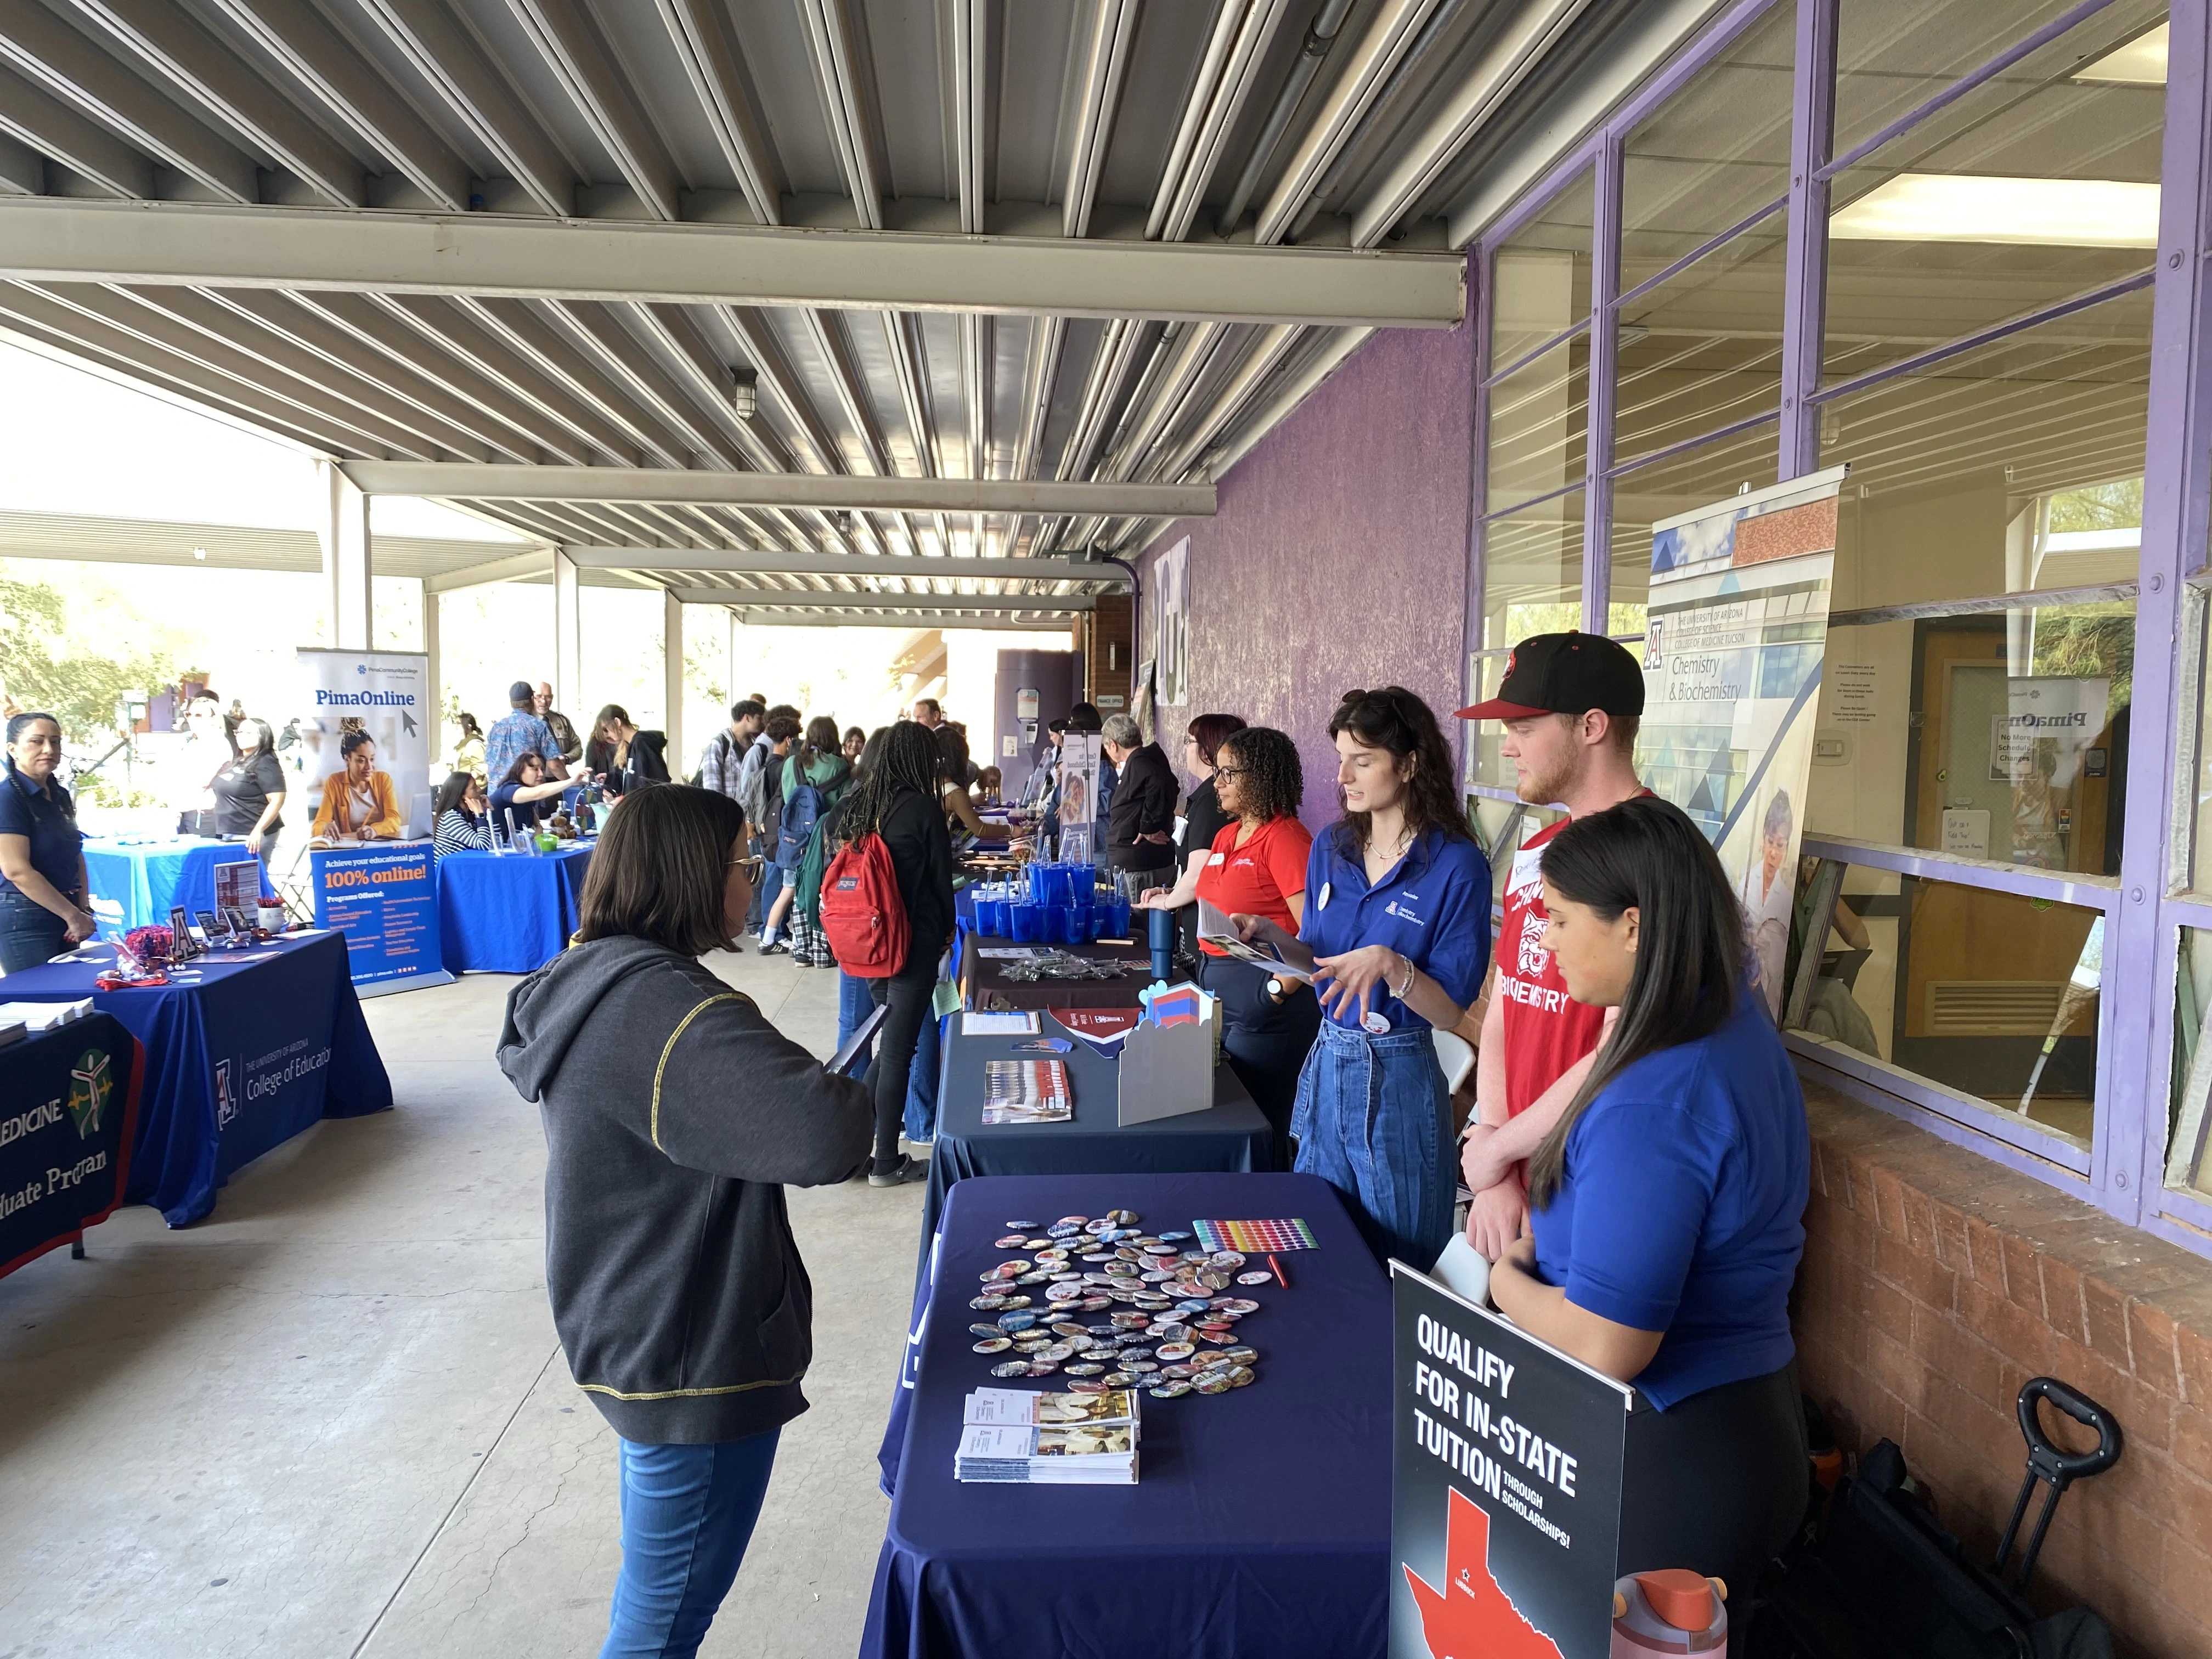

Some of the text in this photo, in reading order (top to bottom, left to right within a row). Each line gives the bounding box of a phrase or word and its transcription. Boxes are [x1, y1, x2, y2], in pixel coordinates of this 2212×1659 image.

[1678, 608, 1743, 625] THE UNIVERSITY OF ARIZONA
[1675, 633, 1746, 649] COLLEGE OF MEDICINE TUCSON
[1676, 623, 1722, 637] COLLEGE OF SCIENCE
[1672, 656, 1720, 678] Chemistry
[315, 690, 415, 706] PimaOnline
[1669, 681, 1742, 704] & Biochemistry
[353, 859, 368, 867] your
[369, 854, 408, 864] educational
[408, 853, 425, 861] goals
[325, 864, 426, 888] 100% online!
[326, 891, 385, 902] Programs Offered:
[246, 1038, 308, 1072] THE UNIVERSITY OF ARIZONA
[247, 1071, 282, 1101] College
[283, 1059, 294, 1082] of
[0, 1098, 64, 1147] EDICINE
[1417, 1313, 1515, 1399] QUALIFY
[1416, 1360, 1577, 1498] FOR IN-STATE
[1414, 1407, 1543, 1510] TUITION THROUGH
[1502, 1489, 1571, 1549] SCHOLARSHIPS!
[1455, 1576, 1476, 1600] LUBBOCK
